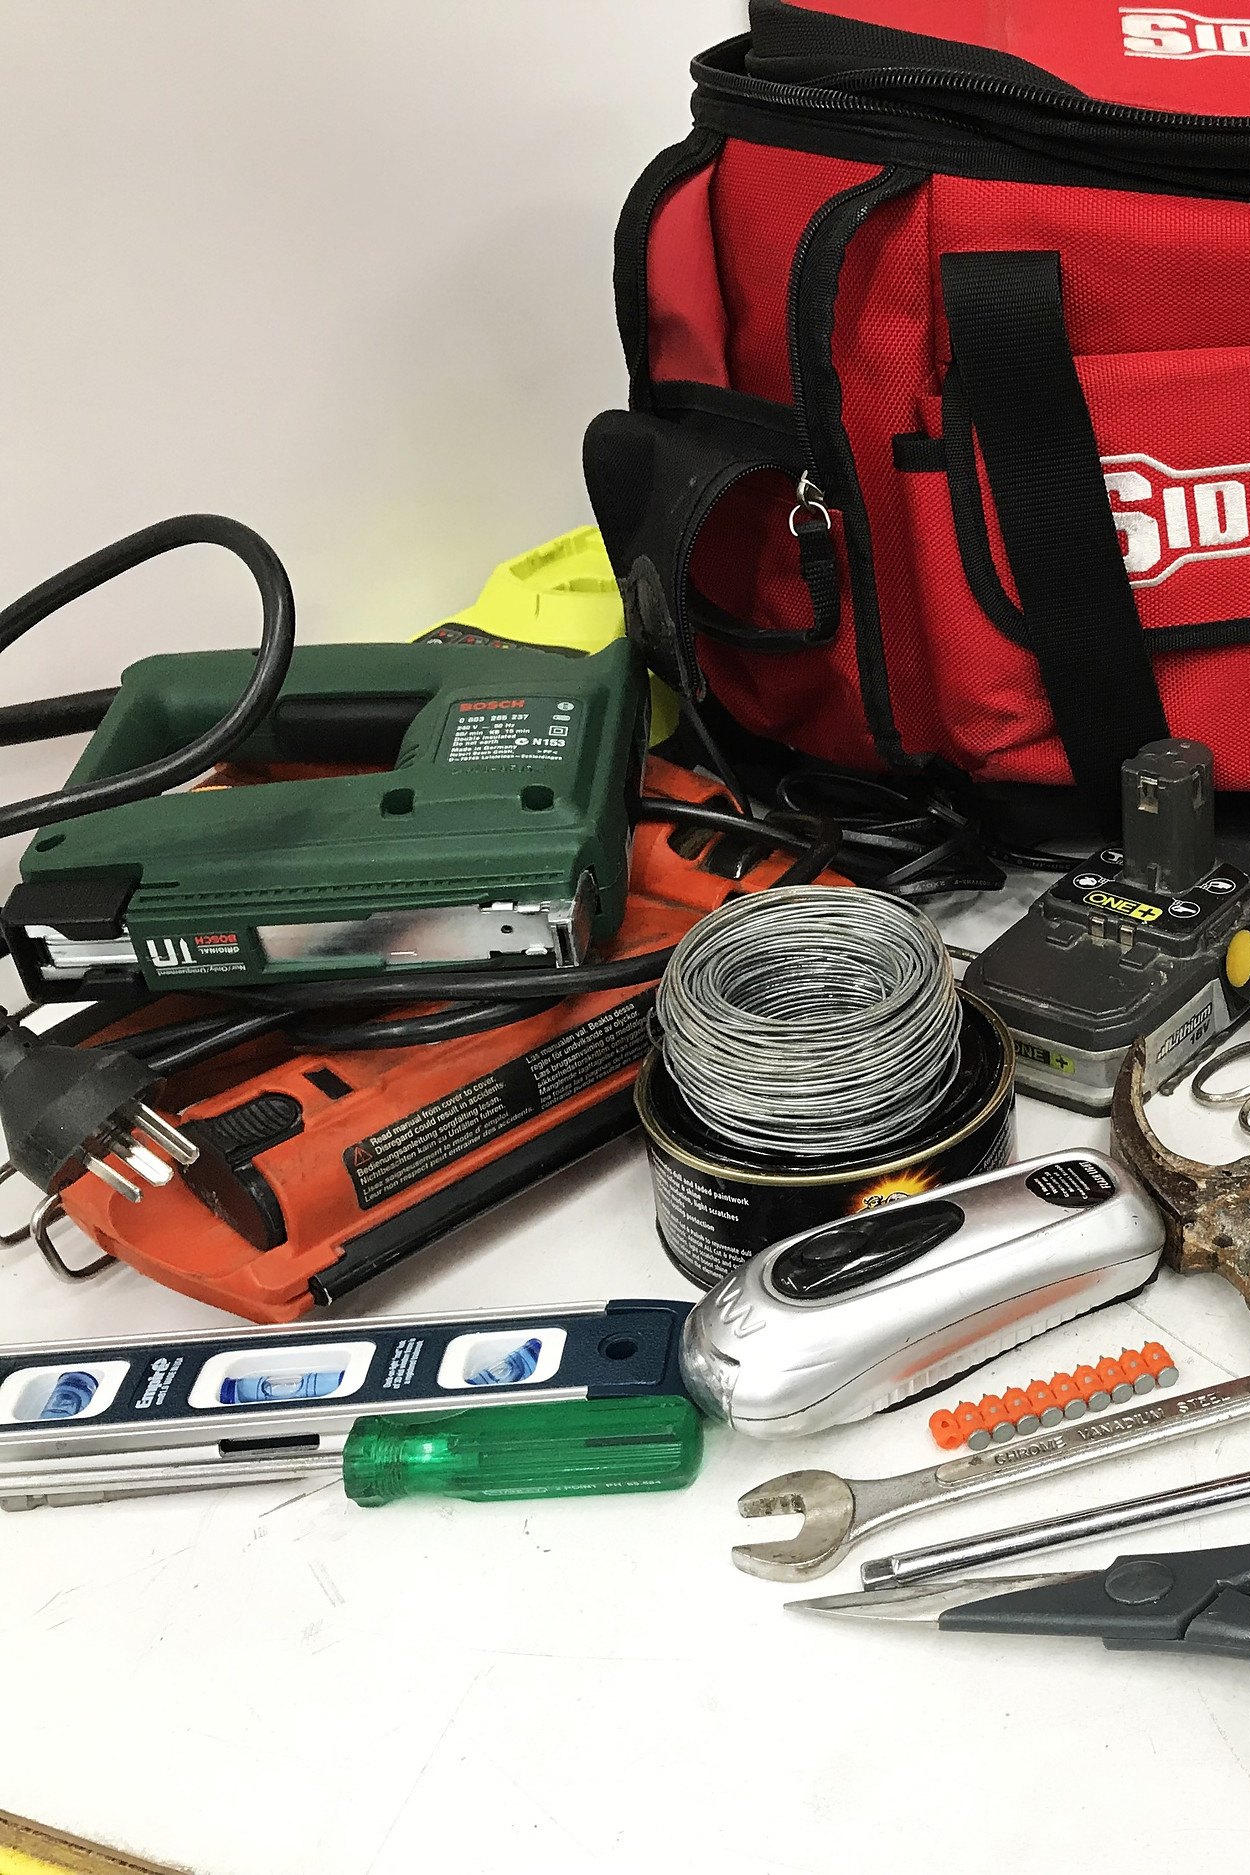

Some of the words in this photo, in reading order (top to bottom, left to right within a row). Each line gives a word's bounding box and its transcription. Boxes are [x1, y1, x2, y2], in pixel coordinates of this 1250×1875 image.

[459, 699, 525, 713] BOSCH
[532, 738, 566, 747] N153
[194, 934, 238, 945] BOSCH
[198, 946, 240, 954] ORIGINAL
[370, 1129, 392, 1146] Read
[393, 1113, 422, 1135] manual
[421, 1105, 441, 1119] from
[441, 1093, 463, 1109] cover
[463, 1089, 473, 1097] to
[375, 1129, 413, 1155] Disregard
[414, 1117, 437, 1134] could
[437, 1104, 459, 1122] result
[460, 1101, 468, 1110] in
[713, 1192, 749, 1206] paintwork
[709, 1208, 739, 1221] scratches
[995, 1435, 1067, 1466] CHROME
[1077, 1408, 1165, 1441] VANADIUM
[1176, 1392, 1231, 1414] STEEL
